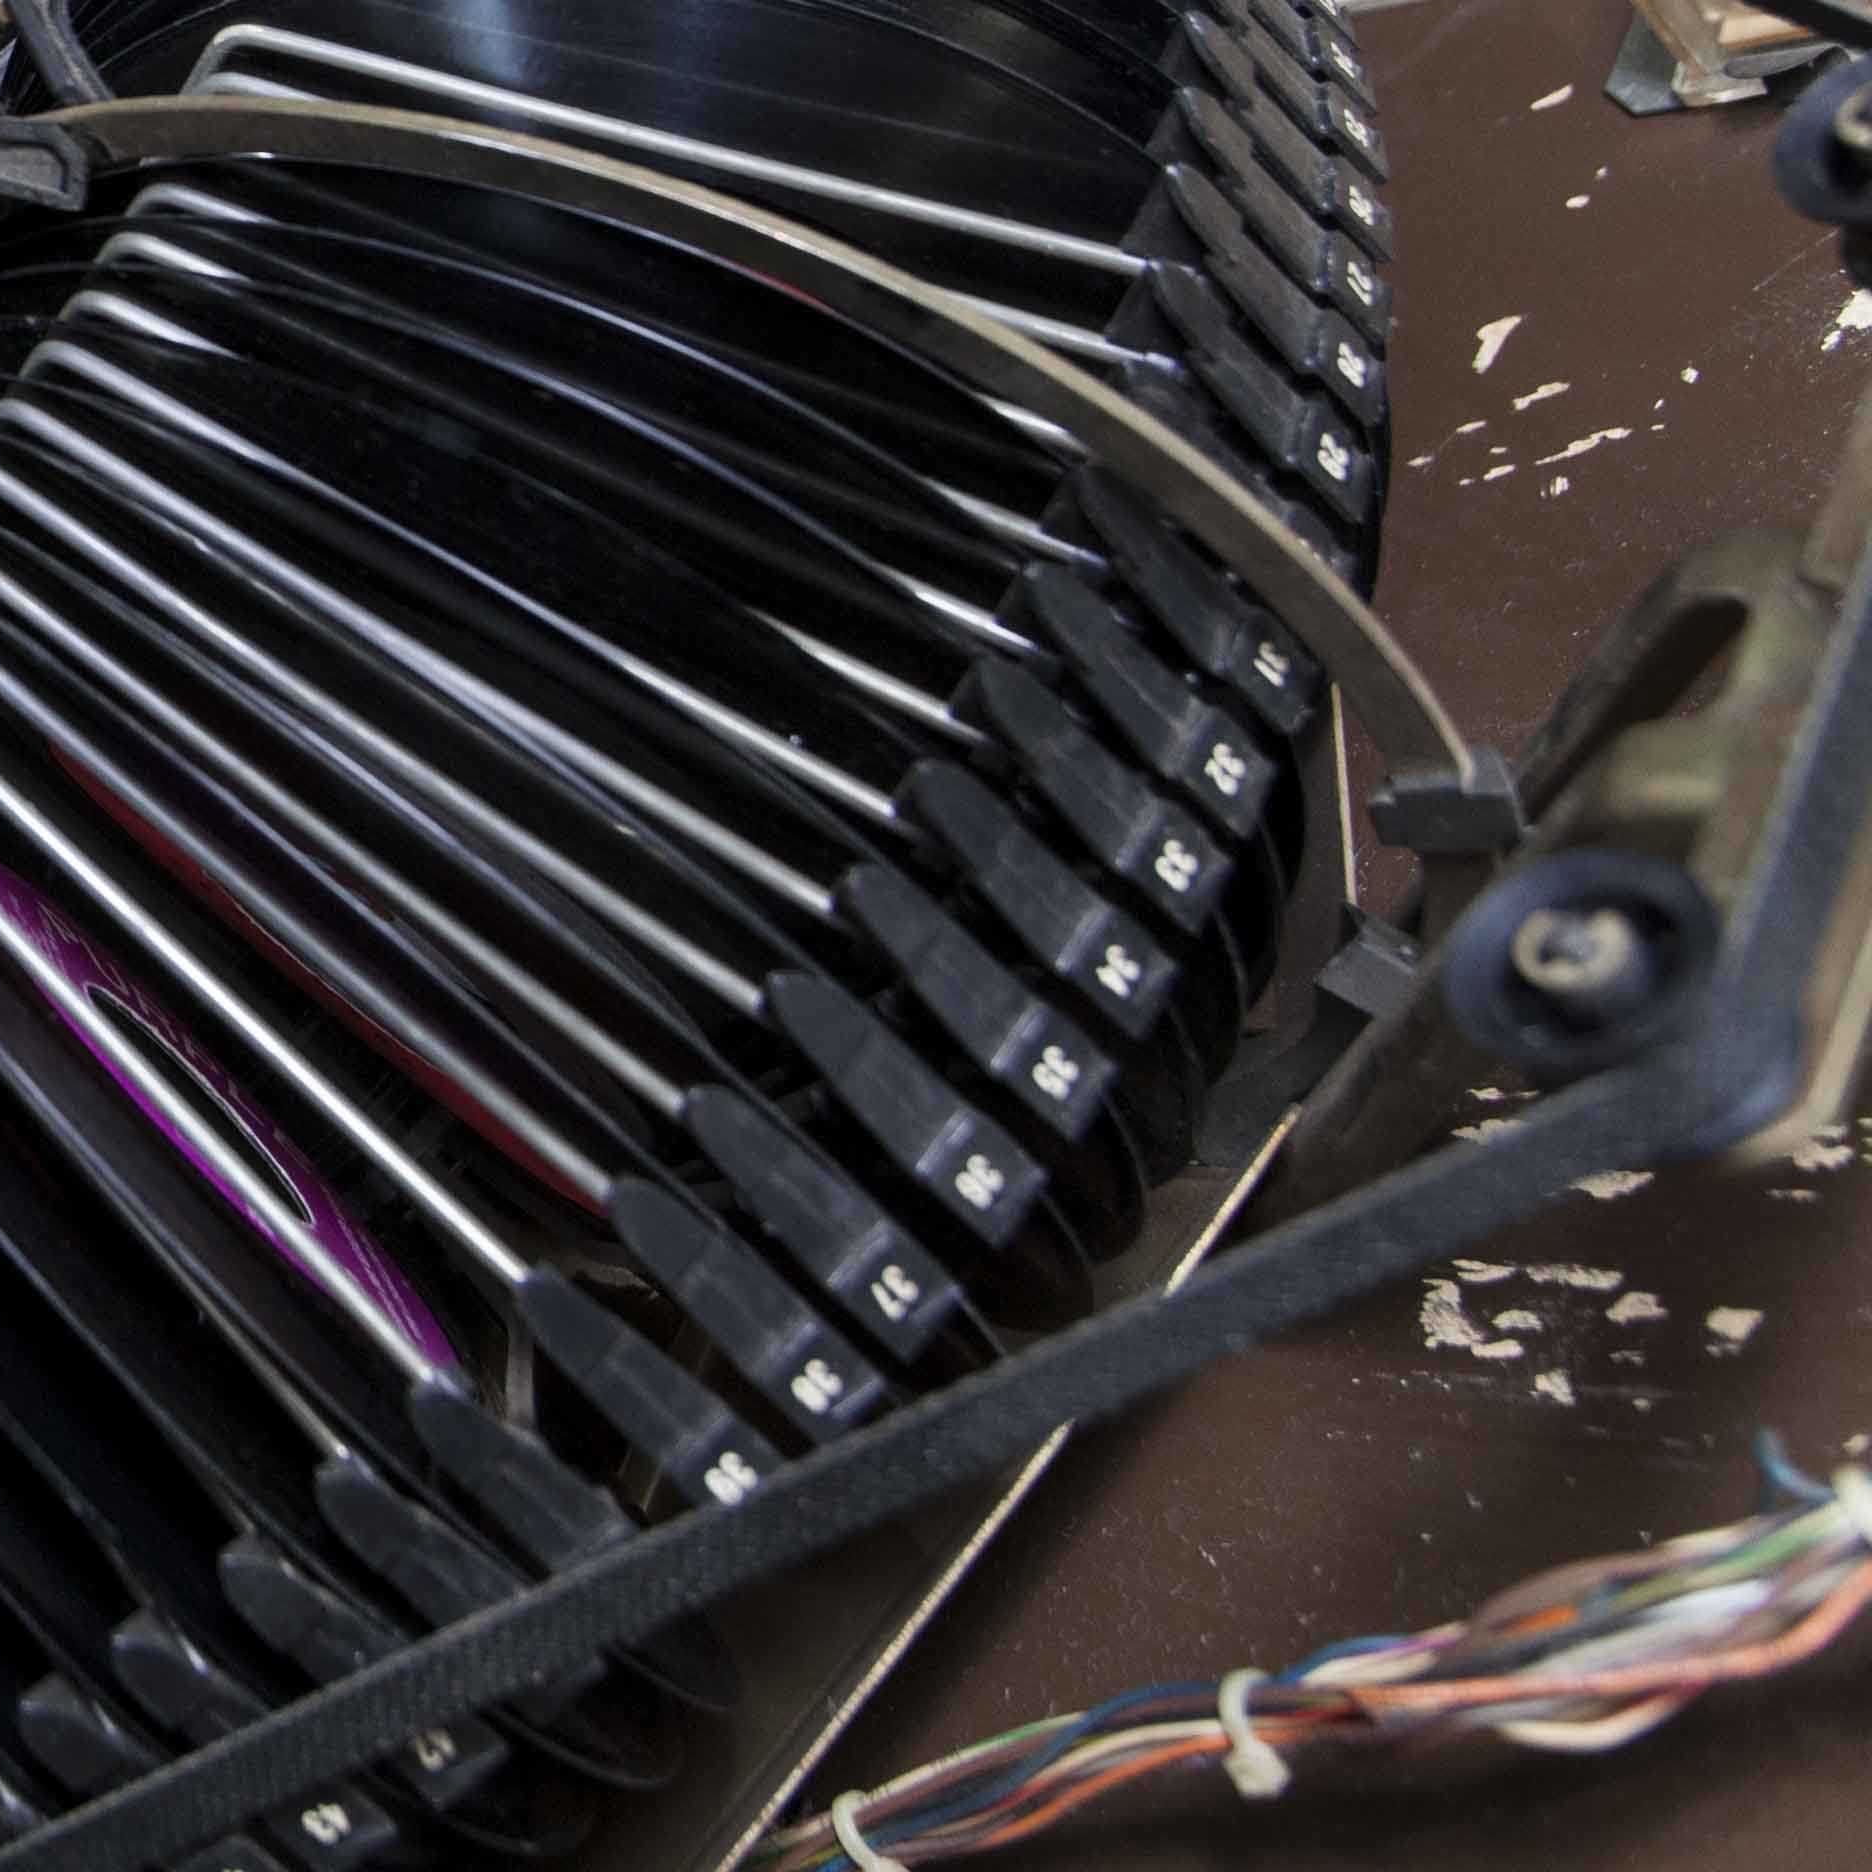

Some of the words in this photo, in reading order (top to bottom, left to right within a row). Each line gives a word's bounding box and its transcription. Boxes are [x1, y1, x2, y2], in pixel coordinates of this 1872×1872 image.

[1253, 640, 1291, 688] 31
[1204, 741, 1247, 797] 32
[1154, 838, 1200, 893] 33
[1095, 942, 1141, 1000] 34
[1031, 1044, 1081, 1102] 35
[954, 1153, 1006, 1210] 36
[870, 1263, 920, 1321] 37
